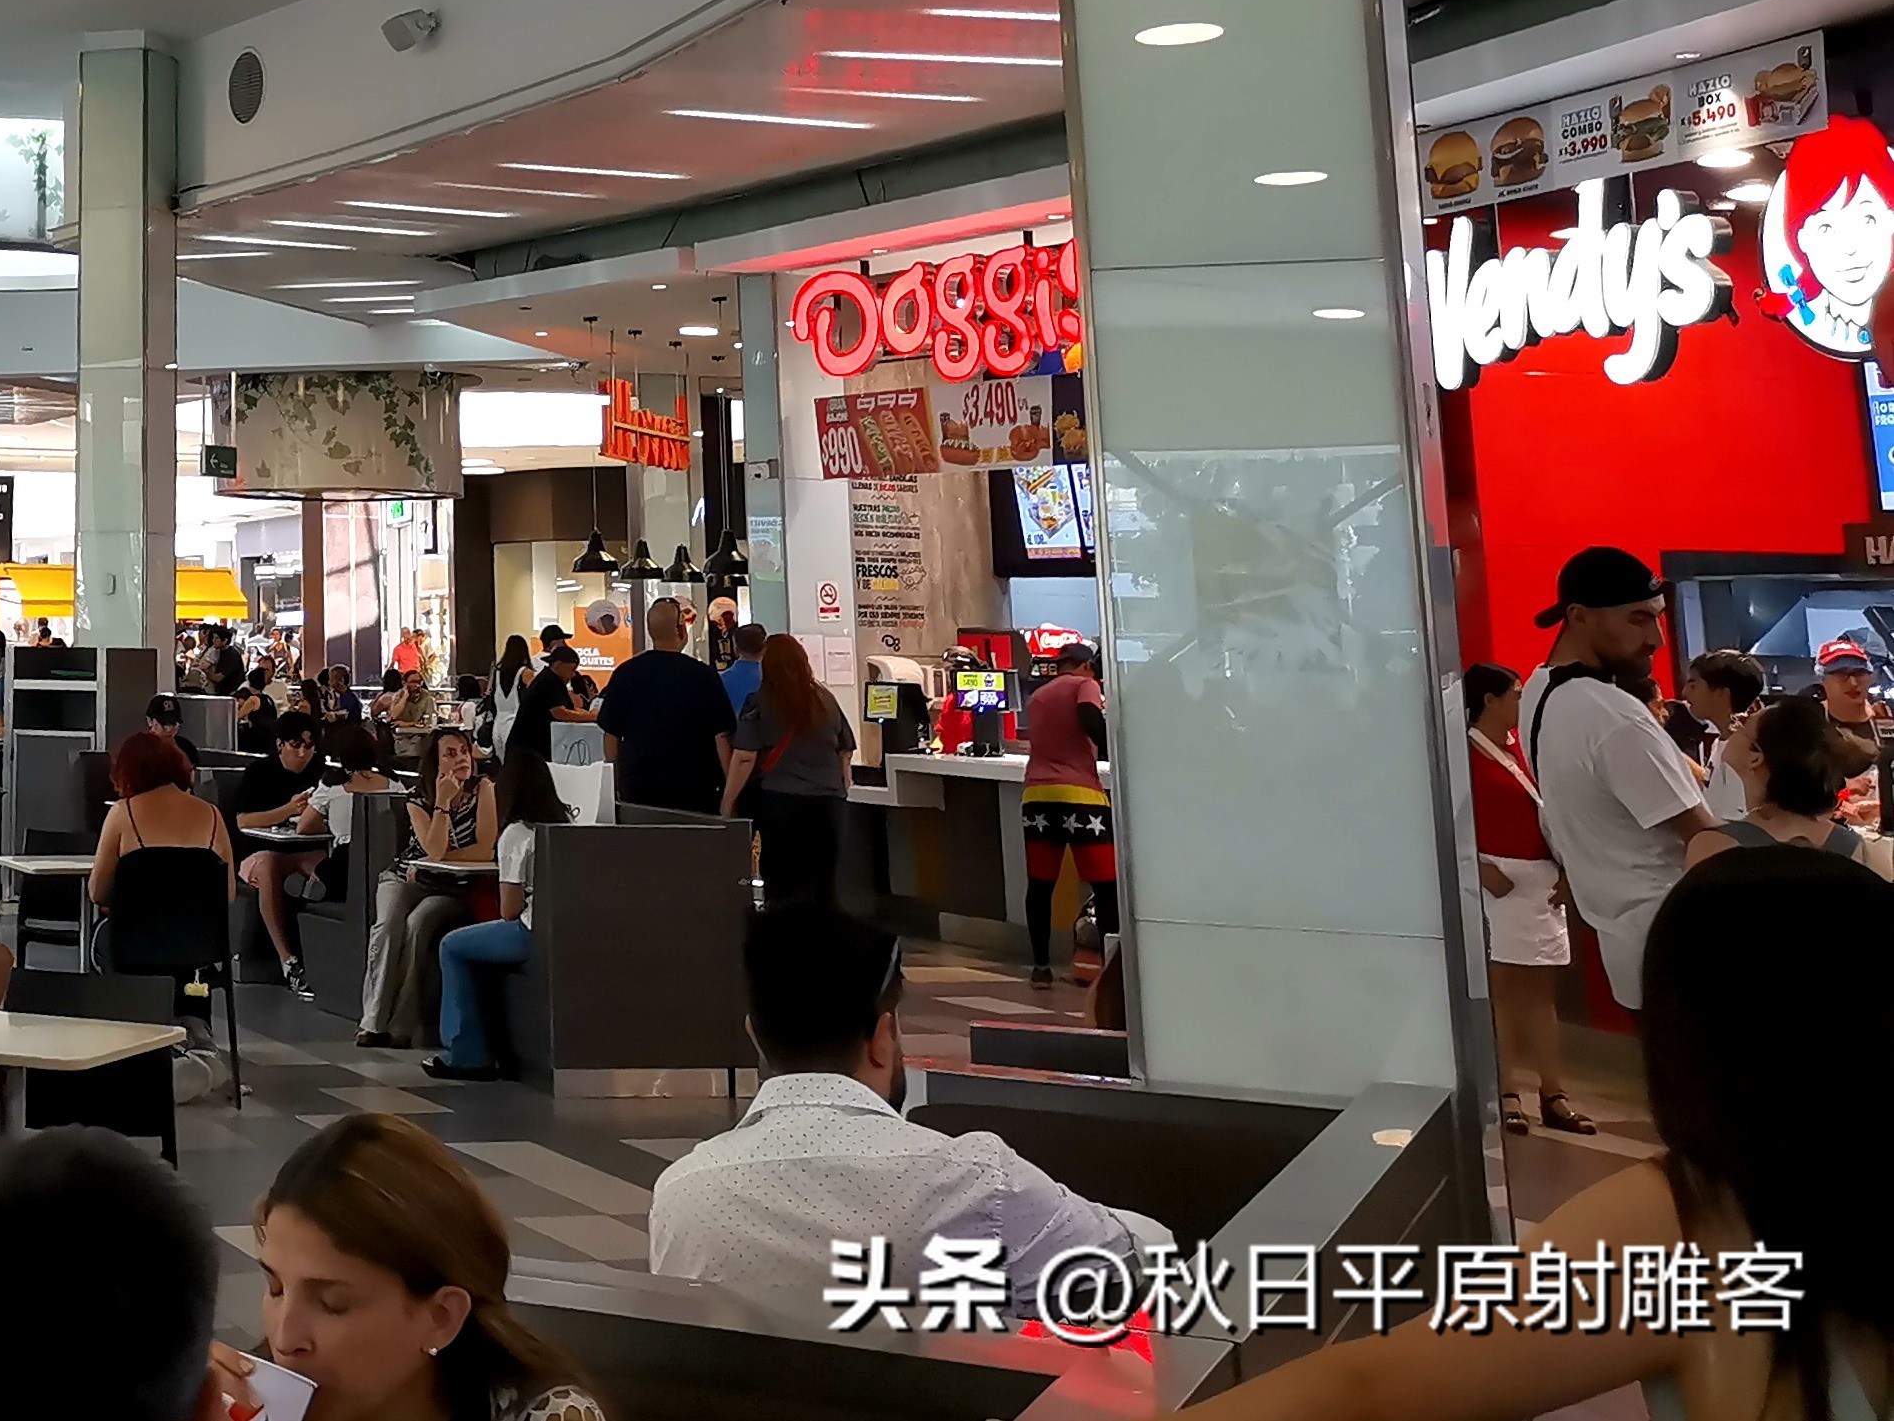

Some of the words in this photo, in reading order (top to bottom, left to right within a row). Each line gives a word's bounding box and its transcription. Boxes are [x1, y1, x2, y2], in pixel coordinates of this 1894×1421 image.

[1687, 73, 1732, 98] HAZLO
[1698, 93, 1721, 108] BOX
[1561, 120, 1603, 140] COMBO
[962, 381, 1018, 429] $3.490
[821, 426, 863, 475] $990
[855, 563, 899, 579] FRESCOS
